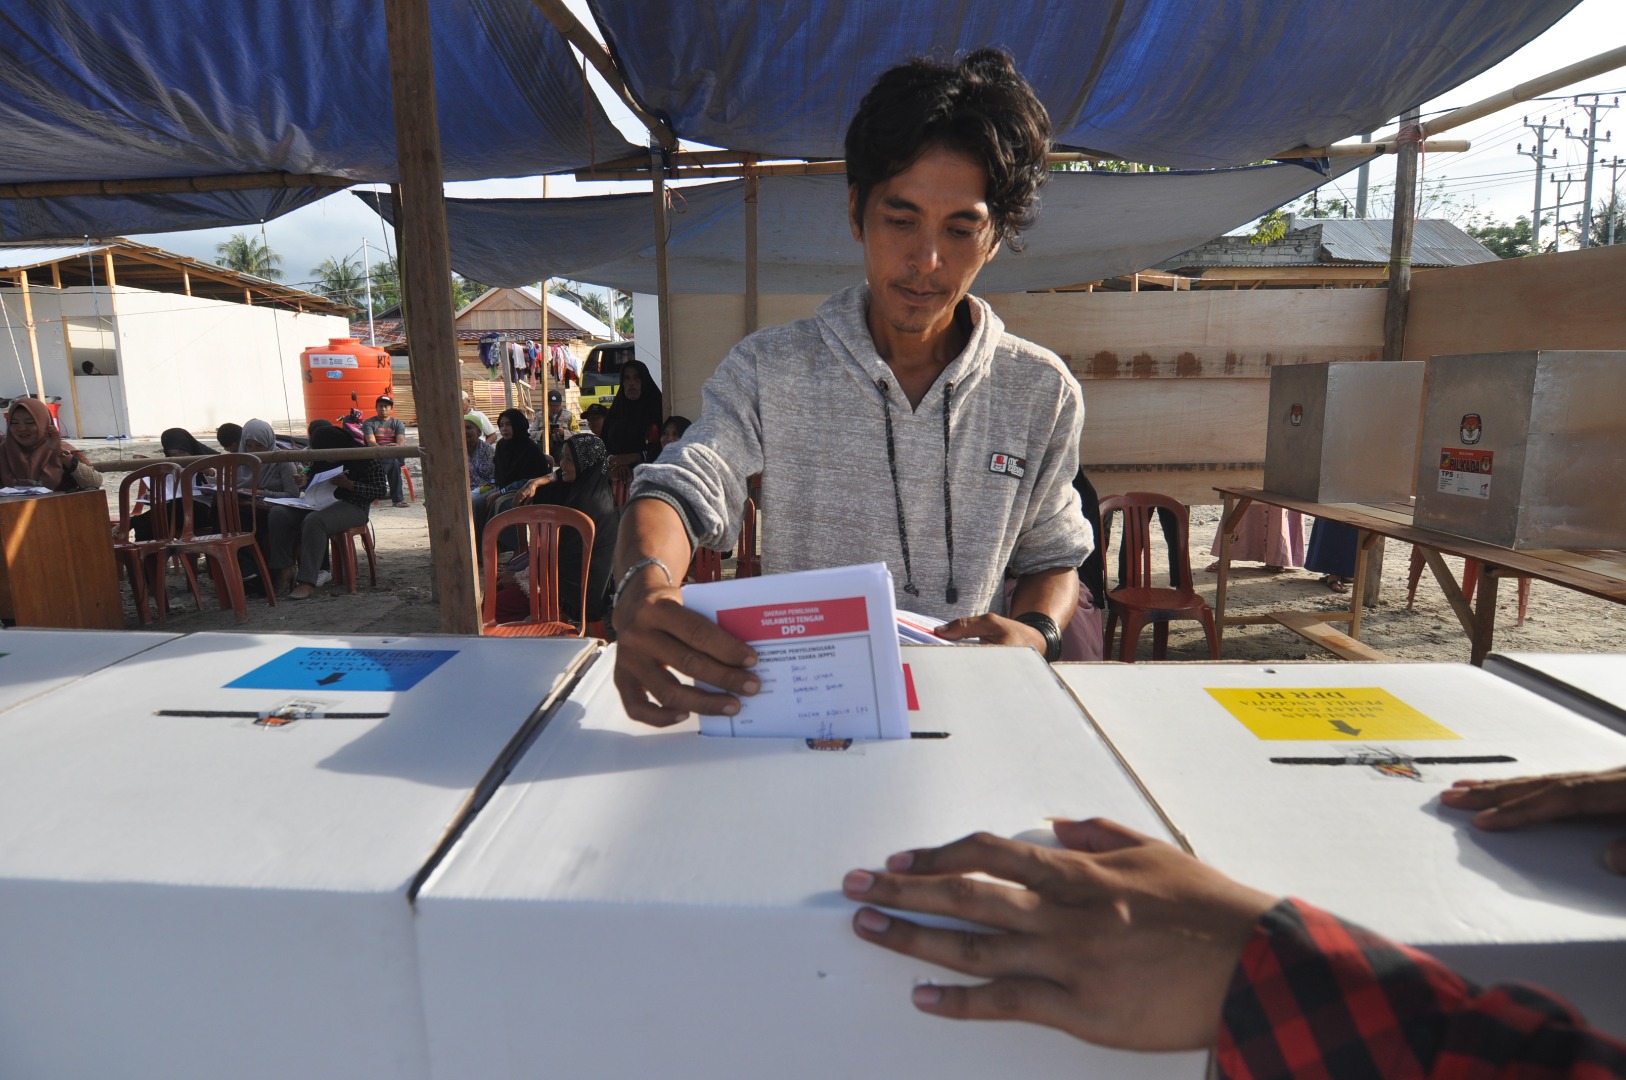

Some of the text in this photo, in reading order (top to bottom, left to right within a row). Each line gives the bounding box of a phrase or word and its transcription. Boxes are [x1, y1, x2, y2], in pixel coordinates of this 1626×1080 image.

[763, 609, 787, 618] DAERAH
[761, 614, 824, 626] SULAWESI TENGAH
[781, 625, 806, 636] DPD
[1254, 691, 1346, 699] DPR RI
